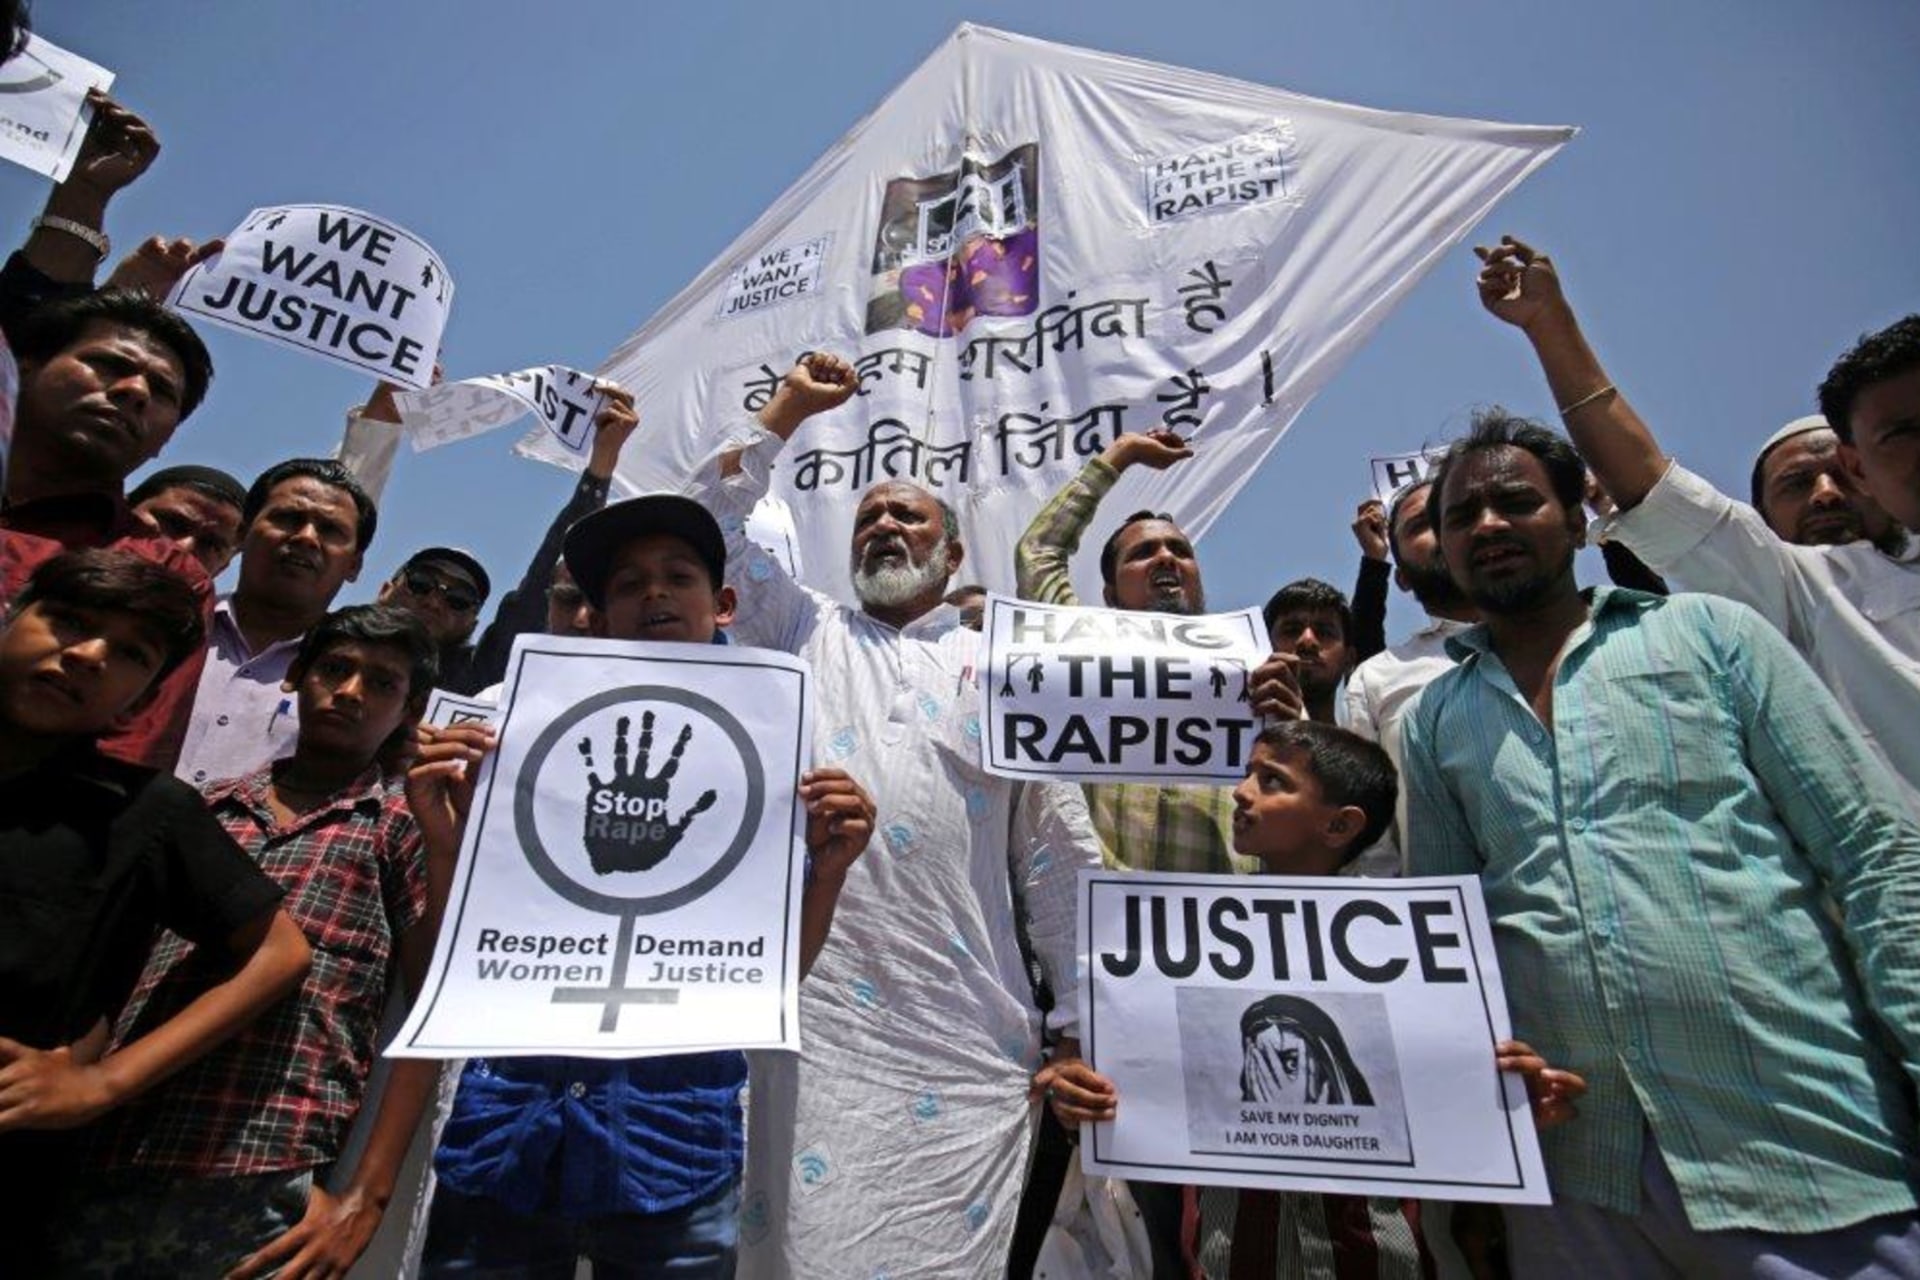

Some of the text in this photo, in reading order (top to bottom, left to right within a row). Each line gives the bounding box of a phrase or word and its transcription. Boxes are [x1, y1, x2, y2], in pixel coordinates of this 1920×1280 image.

[1180, 161, 1247, 189] THE
[1154, 178, 1279, 220] RAPIST
[318, 212, 396, 267] WE
[761, 249, 791, 268] WE
[262, 240, 416, 320] WANT
[743, 263, 802, 290] WANT
[728, 277, 809, 314] JUSTICE
[203, 276, 423, 375] JUSTICE
[958, 290, 1150, 381] शरमिंदा
[1177, 260, 1232, 334] है
[794, 418, 972, 491] कातिल
[995, 401, 1128, 475] जिंदा
[1012, 610, 1233, 649] HANG
[1058, 655, 1192, 700] THE
[1004, 713, 1254, 767] RAPIST
[592, 789, 664, 821] Stop
[589, 814, 666, 845] Rape
[476, 929, 609, 958] Respect
[634, 934, 764, 957] Demand
[1101, 895, 1469, 983] JUSTICE
[477, 959, 603, 981] Women
[648, 962, 764, 983] Justice
[1240, 1110, 1360, 1127] SAVE MY DIGNITY
[1226, 1131, 1380, 1151] I AM YOUR DAUGHTER
